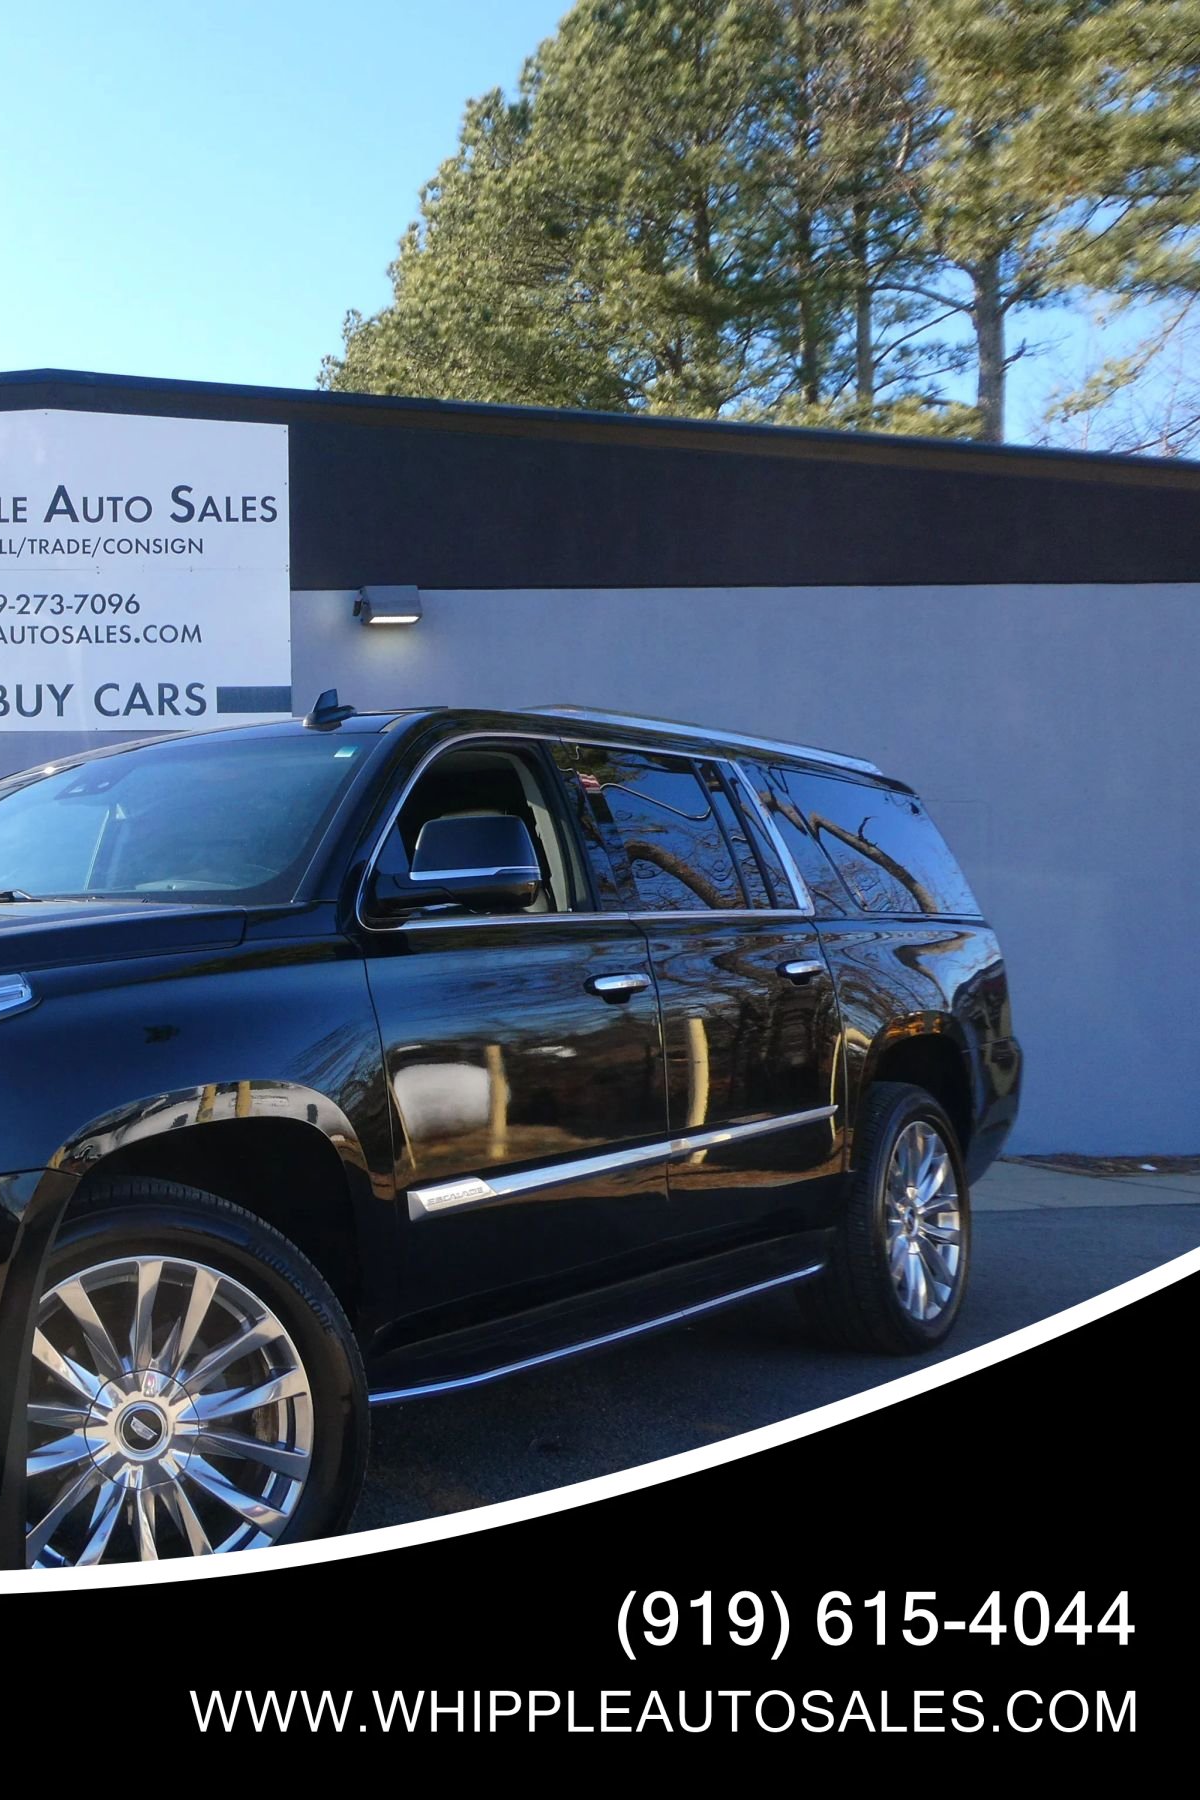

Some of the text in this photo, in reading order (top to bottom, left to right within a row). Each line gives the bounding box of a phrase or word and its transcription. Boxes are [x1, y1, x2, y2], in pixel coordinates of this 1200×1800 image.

[44, 485, 153, 523] AUTO
[170, 484, 278, 523] SALES
[94, 683, 207, 717] CARS
